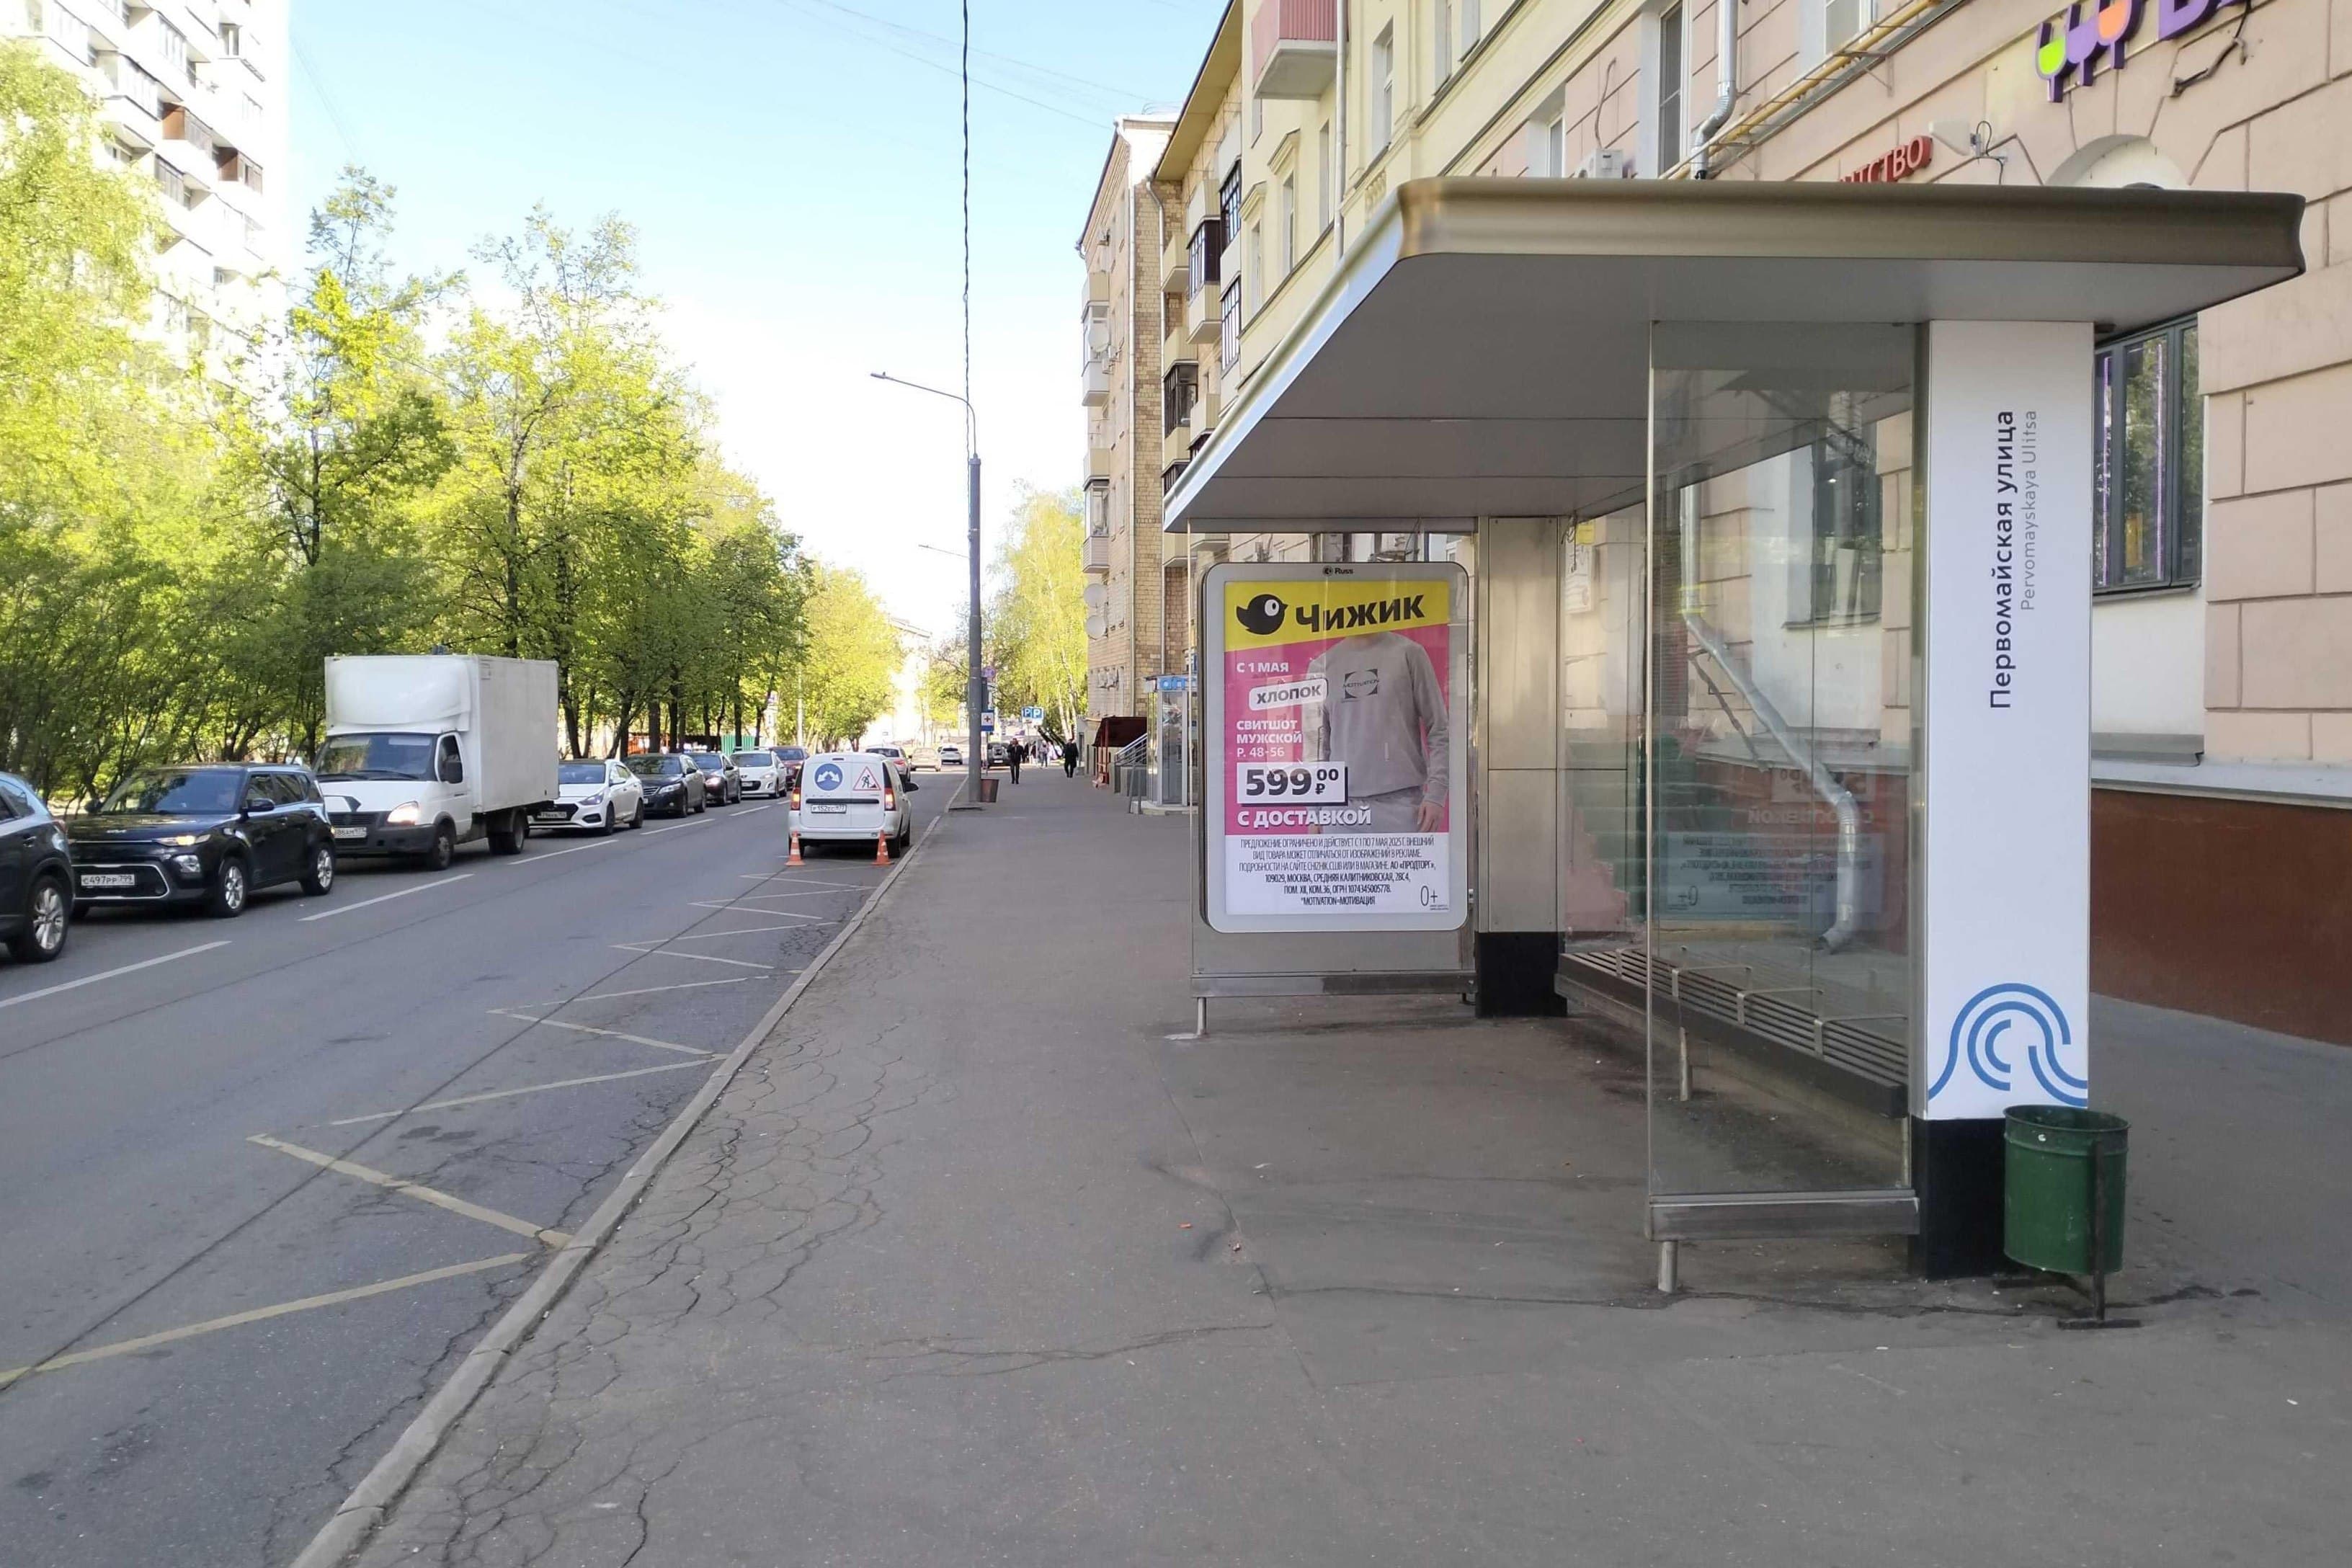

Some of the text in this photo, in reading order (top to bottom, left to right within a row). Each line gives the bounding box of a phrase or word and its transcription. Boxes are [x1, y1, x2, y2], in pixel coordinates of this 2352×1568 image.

[2021, 410, 2039, 610] Pervomayskaya Ulitsa
[1990, 410, 2018, 708] Первомайская улица
[1237, 662, 1289, 672] С 1 МАЯ
[1257, 685, 1321, 704] ХЛОПОК
[1237, 720, 1297, 730] СВИТШОТ
[1237, 731, 1302, 744] МУЖСКОЙ
[1237, 747, 1285, 757] Р. 48-56
[1246, 768, 1339, 796] 599 00
[1237, 806, 1371, 828] С ДОСТАВКОЙ
[1241, 839, 1281, 849] ПРЕДЛОЖЕНИЕ
[1283, 838, 1317, 847] ОГРАНИЧЕНО
[1319, 838, 1323, 847] И
[1324, 837, 1353, 848] ДЕЙСТВУЕТ
[1363, 837, 1371, 846] ПО
[1376, 837, 1388, 847] МАЯ
[1389, 837, 1401, 846] 2025
[1407, 835, 1434, 846] ВНЕШНИЙ
[1253, 850, 1265, 860] ВИД
[1266, 850, 1286, 860] ТОВАРА
[1286, 850, 1306, 859] МОЖЕТ
[1308, 850, 1341, 859] ОТЛИЧАТЬСЯ
[1342, 850, 1349, 858] ОТ
[1239, 862, 1280, 873] ПОДРОБНОСТИ
[1281, 862, 1288, 870] НА
[1290, 860, 1306, 870] САЙТЕ
[1343, 861, 1355, 870] ИЛИ
[1390, 860, 1399, 869] АО
[1287, 873, 1312, 883] МОСКВА,
[1314, 873, 1339, 883] СРЕДНЯЯ
[1332, 884, 1347, 894] ОГРН
[1420, 886, 1438, 906] 0+
